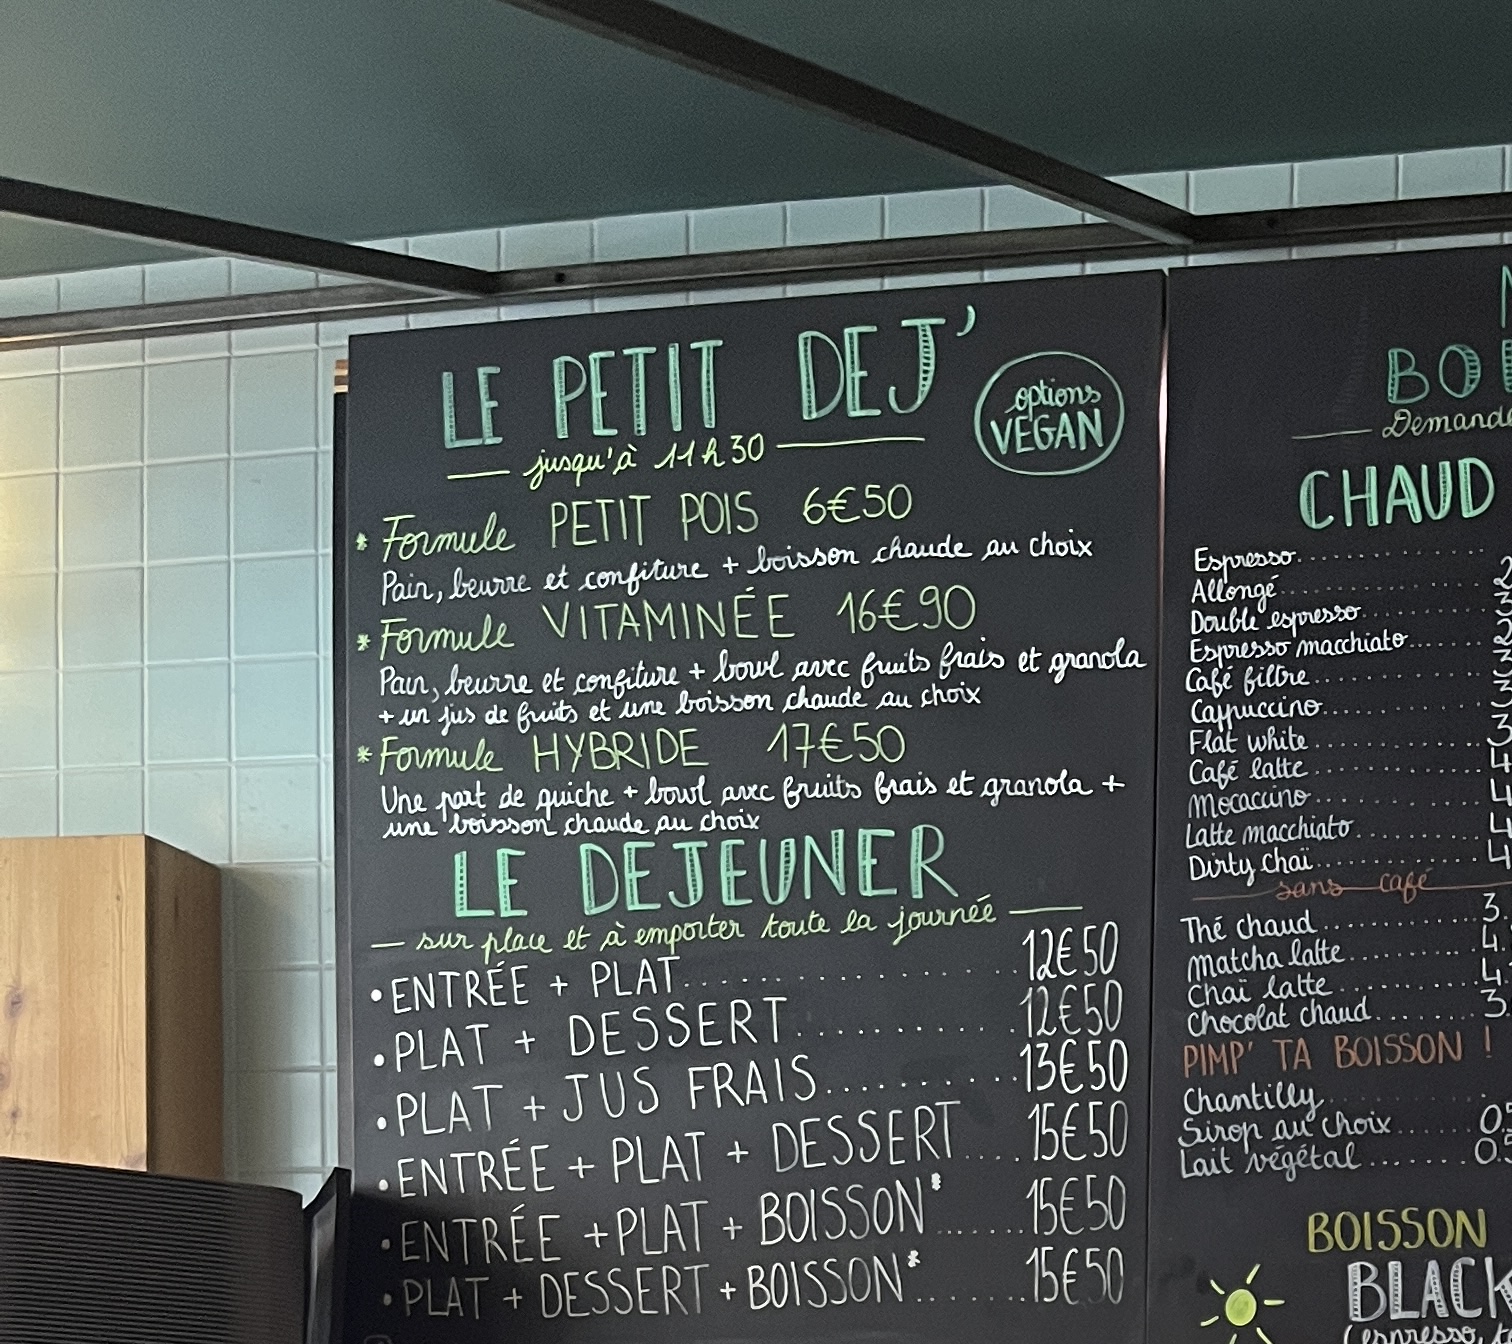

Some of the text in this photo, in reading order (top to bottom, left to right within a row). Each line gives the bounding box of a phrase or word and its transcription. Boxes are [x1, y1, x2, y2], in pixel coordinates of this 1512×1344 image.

[443, 367, 502, 448] LE
[553, 340, 723, 438] PETIT
[1005, 380, 1101, 422] options
[990, 408, 1103, 454] VEGAN
[1300, 458, 1494, 528] CHAUD
[383, 484, 911, 562] Formule PETIT POIS 6€50
[1195, 547, 1296, 582] Espresso
[380, 585, 975, 660] Formule VITAMINÉE 16€90
[1191, 639, 1291, 668] Espresso
[1296, 629, 1408, 657] macchiato
[380, 722, 905, 775] Formule HYBRIDE 17€50
[455, 824, 959, 917] LE DEJEUNER
[416, 894, 996, 964] sur place et à emporter toute la journée
[392, 922, 1118, 1013] ENTRÉE + PLAT 12€50
[1188, 1003, 1290, 1037] Chocolat
[1300, 996, 1371, 1027] chaud
[1273, 1038, 1311, 1070] TA
[1335, 1031, 1462, 1068] BOISSON
[1184, 1082, 1324, 1122] Chantilly
[1309, 1207, 1486, 1252] BOISSON
